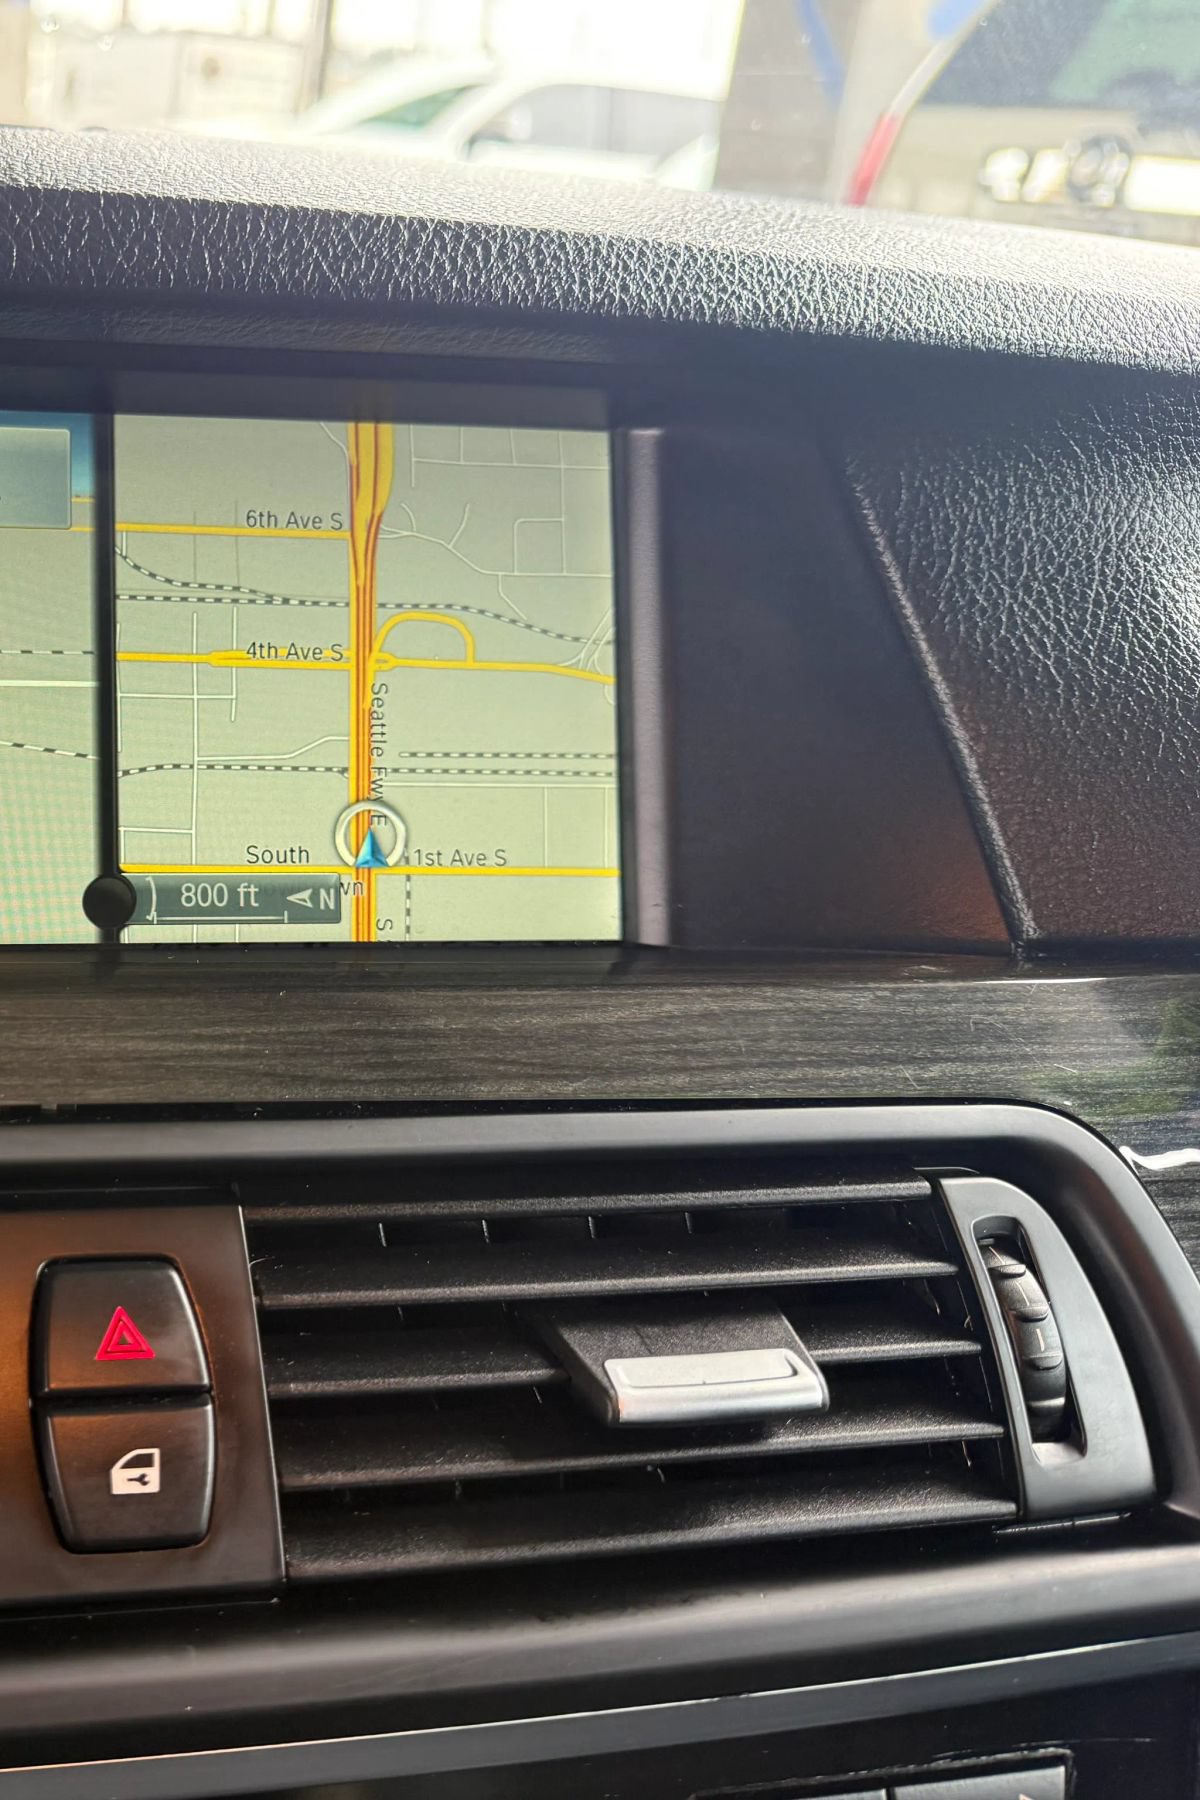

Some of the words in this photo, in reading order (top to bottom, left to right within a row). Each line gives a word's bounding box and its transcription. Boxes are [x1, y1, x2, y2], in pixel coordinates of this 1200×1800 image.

[245, 509, 278, 529] 6th
[285, 511, 323, 530] Ave
[330, 512, 343, 531] S
[245, 641, 278, 660] 4th
[285, 642, 323, 661] Ave
[330, 643, 344, 662] S
[370, 682, 389, 758] Seattle
[246, 845, 310, 865] South
[413, 848, 444, 867] 1st
[450, 848, 487, 868] Ave
[494, 848, 508, 868] S
[180, 882, 229, 908] 800
[236, 882, 260, 908] ft
[319, 887, 336, 911] N
